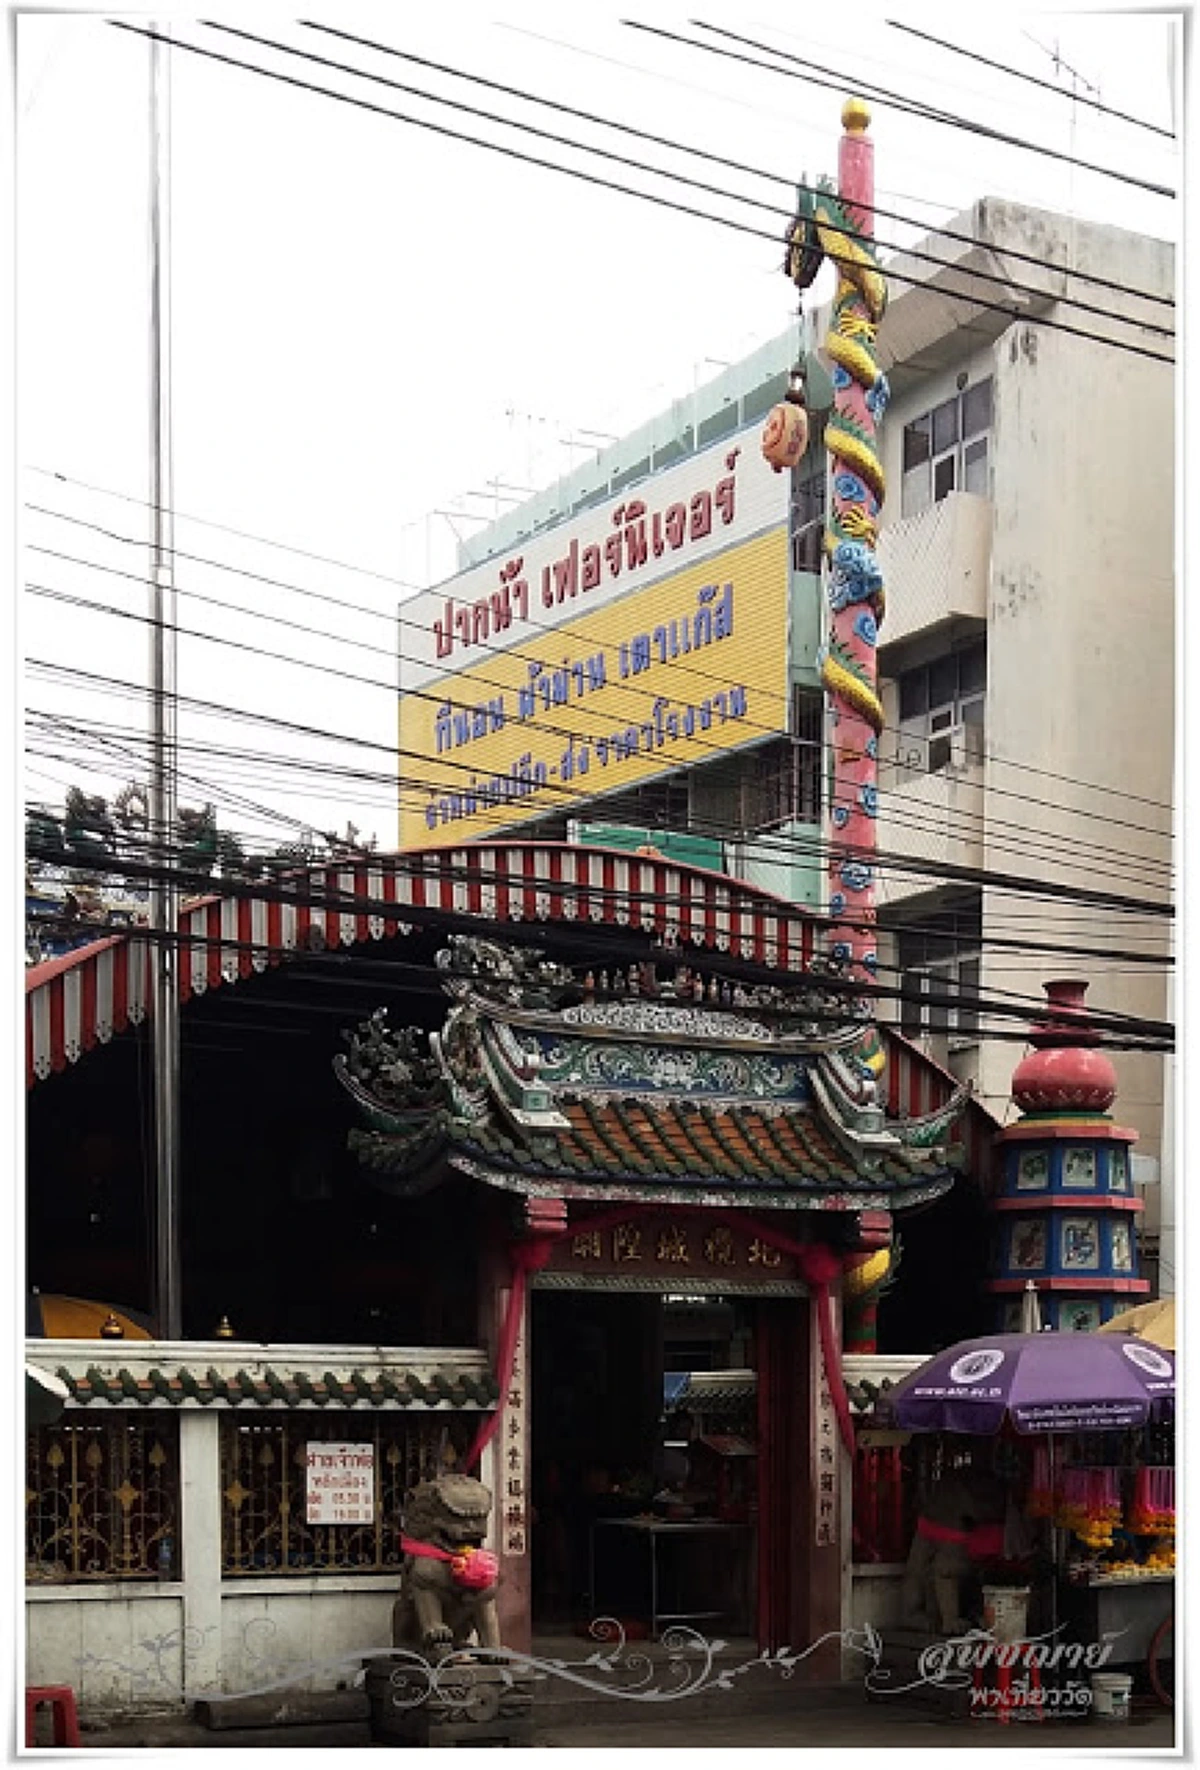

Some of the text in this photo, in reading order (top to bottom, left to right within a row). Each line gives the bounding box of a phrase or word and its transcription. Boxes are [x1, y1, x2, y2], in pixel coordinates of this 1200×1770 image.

[433, 446, 742, 658] ปากน้ำ เฟอร์นิเจอร์
